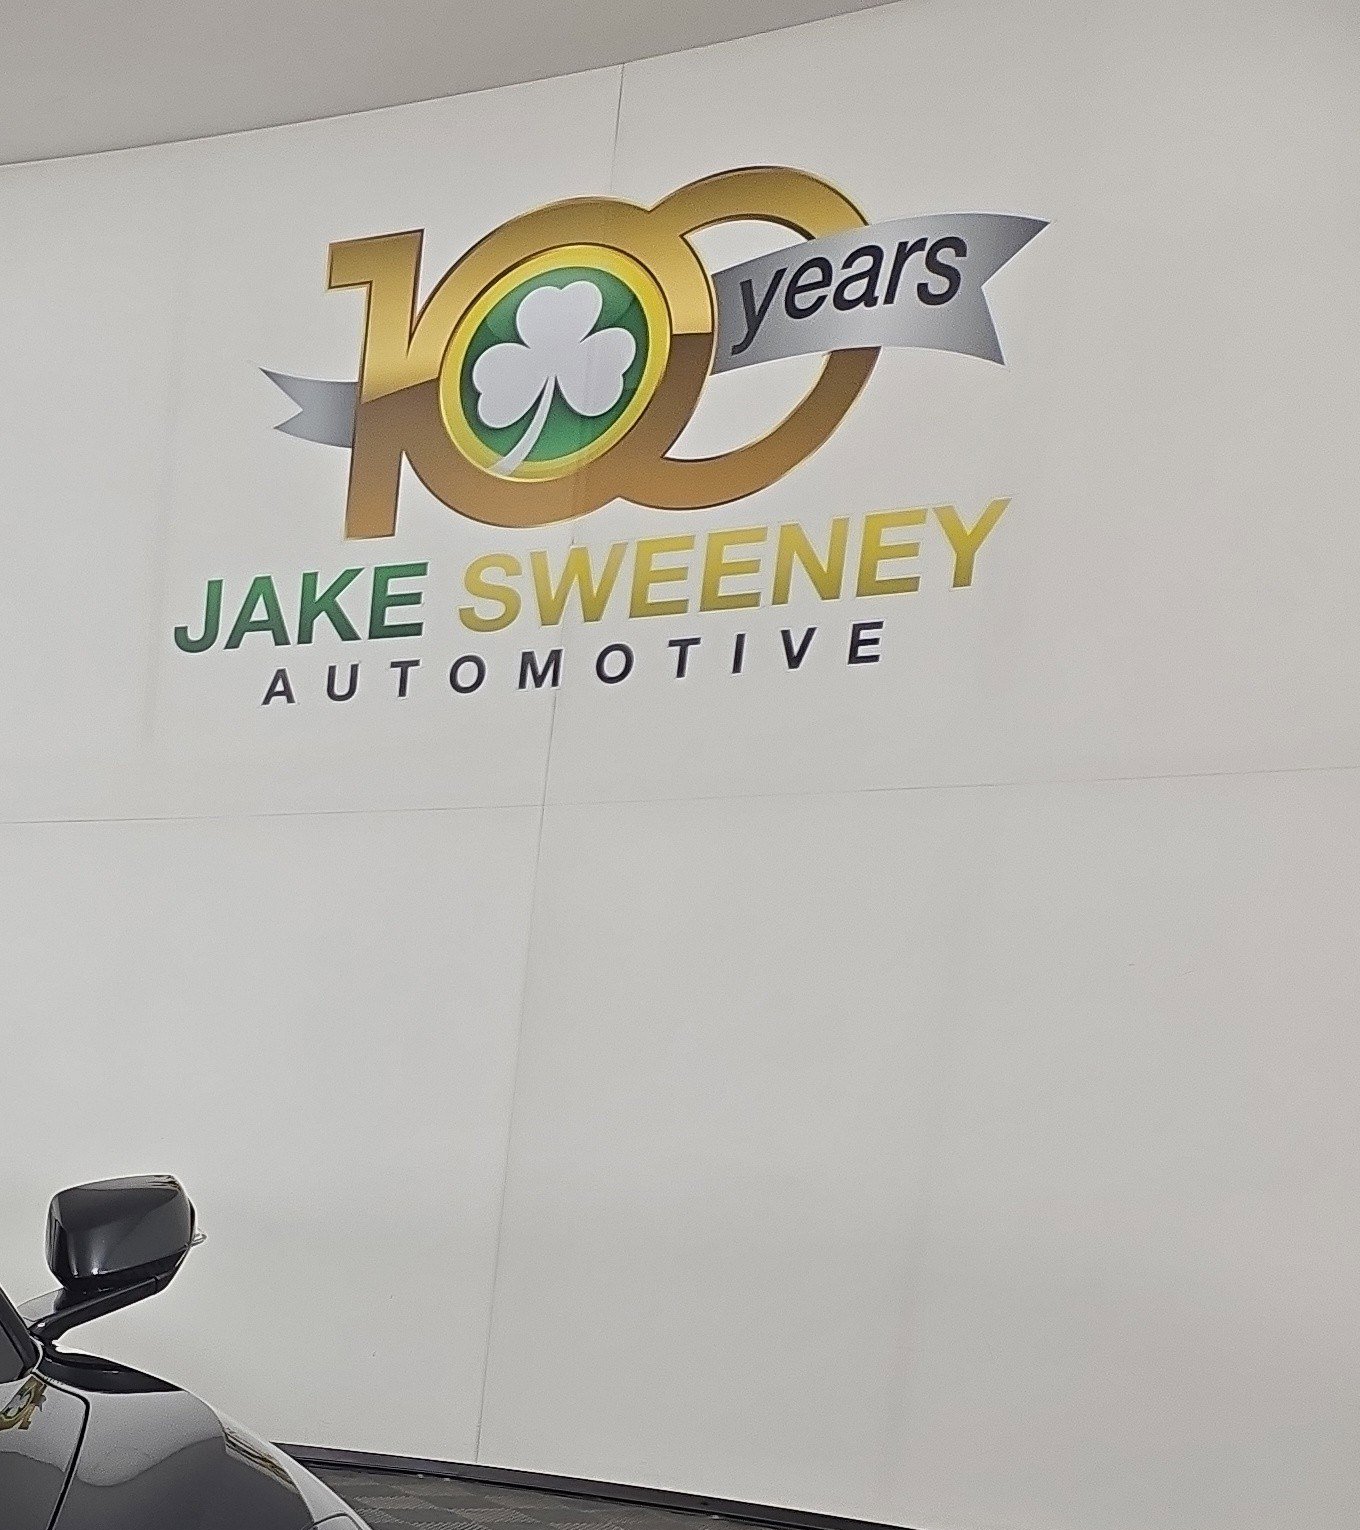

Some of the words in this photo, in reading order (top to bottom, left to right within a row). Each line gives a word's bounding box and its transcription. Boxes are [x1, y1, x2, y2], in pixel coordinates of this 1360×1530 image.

[326, 165, 881, 540] 100
[730, 234, 969, 356] years
[174, 560, 429, 654] JAKE
[457, 497, 1012, 634] SWEENEY
[261, 620, 886, 706] AUTOMOTIVE
